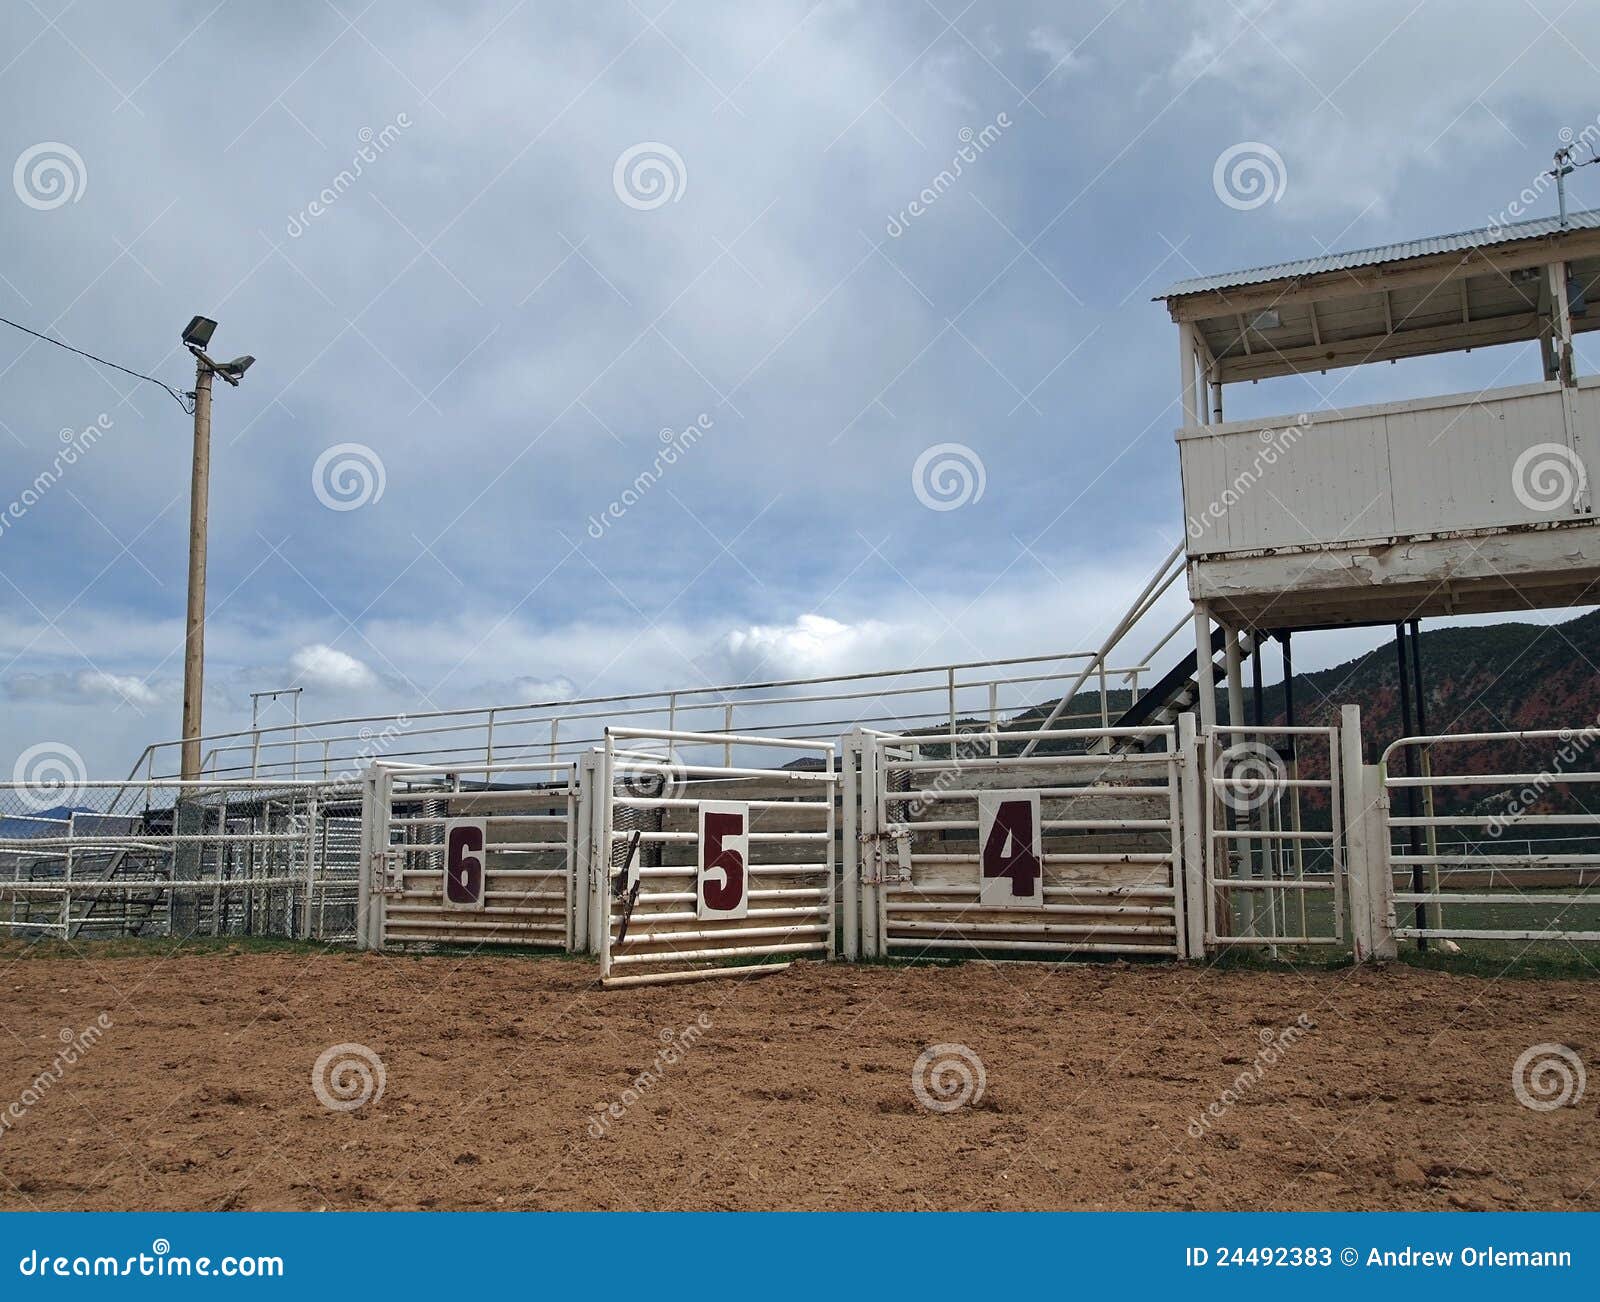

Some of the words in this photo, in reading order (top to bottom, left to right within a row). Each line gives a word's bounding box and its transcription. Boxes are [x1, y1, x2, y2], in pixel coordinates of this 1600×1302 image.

[447, 826, 482, 903] 6
[703, 812, 743, 910] 5
[983, 800, 1040, 896] 4
